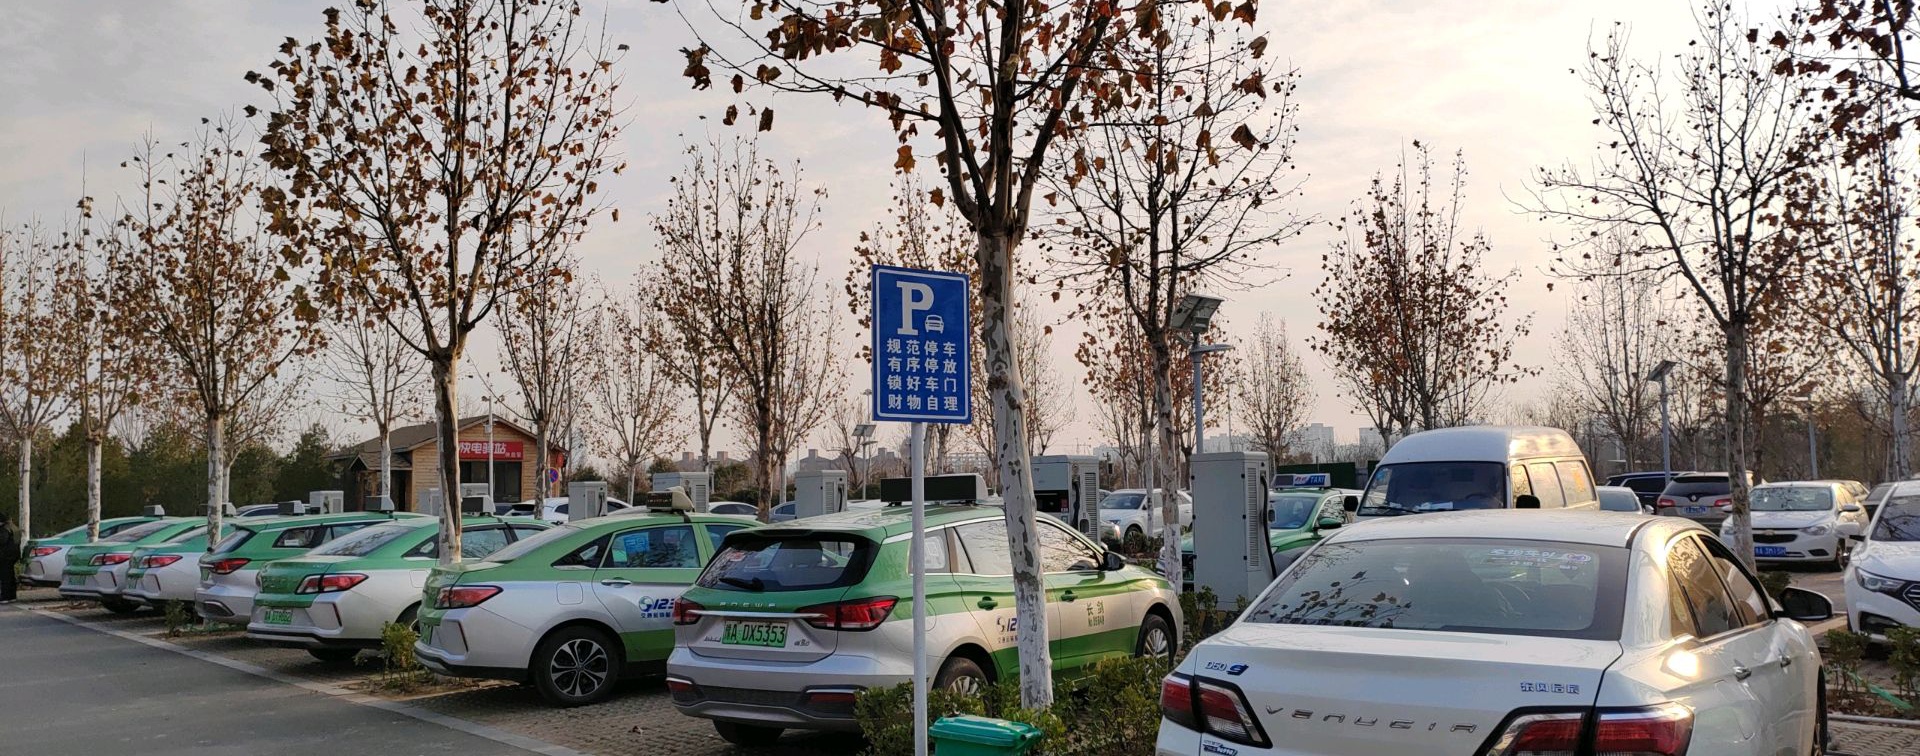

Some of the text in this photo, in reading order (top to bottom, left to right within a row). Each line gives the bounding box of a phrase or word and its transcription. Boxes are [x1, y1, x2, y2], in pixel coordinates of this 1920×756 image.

[896, 281, 934, 335] P
[887, 338, 957, 357] 规范停车
[888, 357, 957, 374] 有序停放
[887, 374, 957, 393] 锁好车门
[888, 394, 958, 412] 财物自理
[742, 624, 786, 644] DX5353
[1205, 661, 1227, 671] D50
[1520, 682, 1580, 694] 东风启辰
